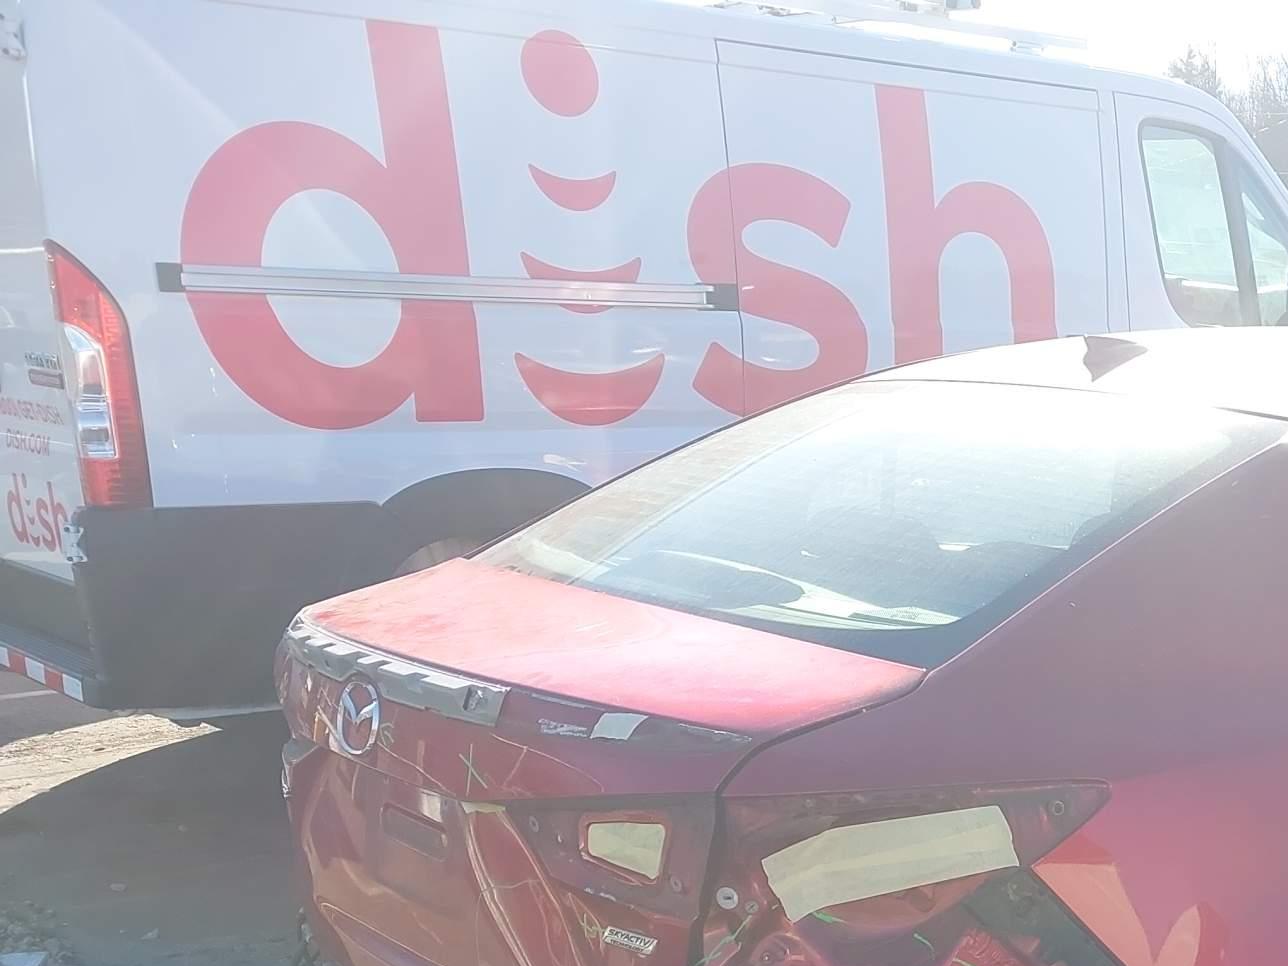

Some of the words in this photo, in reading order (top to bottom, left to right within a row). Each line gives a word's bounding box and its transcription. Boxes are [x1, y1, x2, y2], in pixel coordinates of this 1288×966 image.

[180, 18, 1057, 431] dish
[7, 472, 69, 555] dish
[607, 928, 652, 947] SKYACTIV
